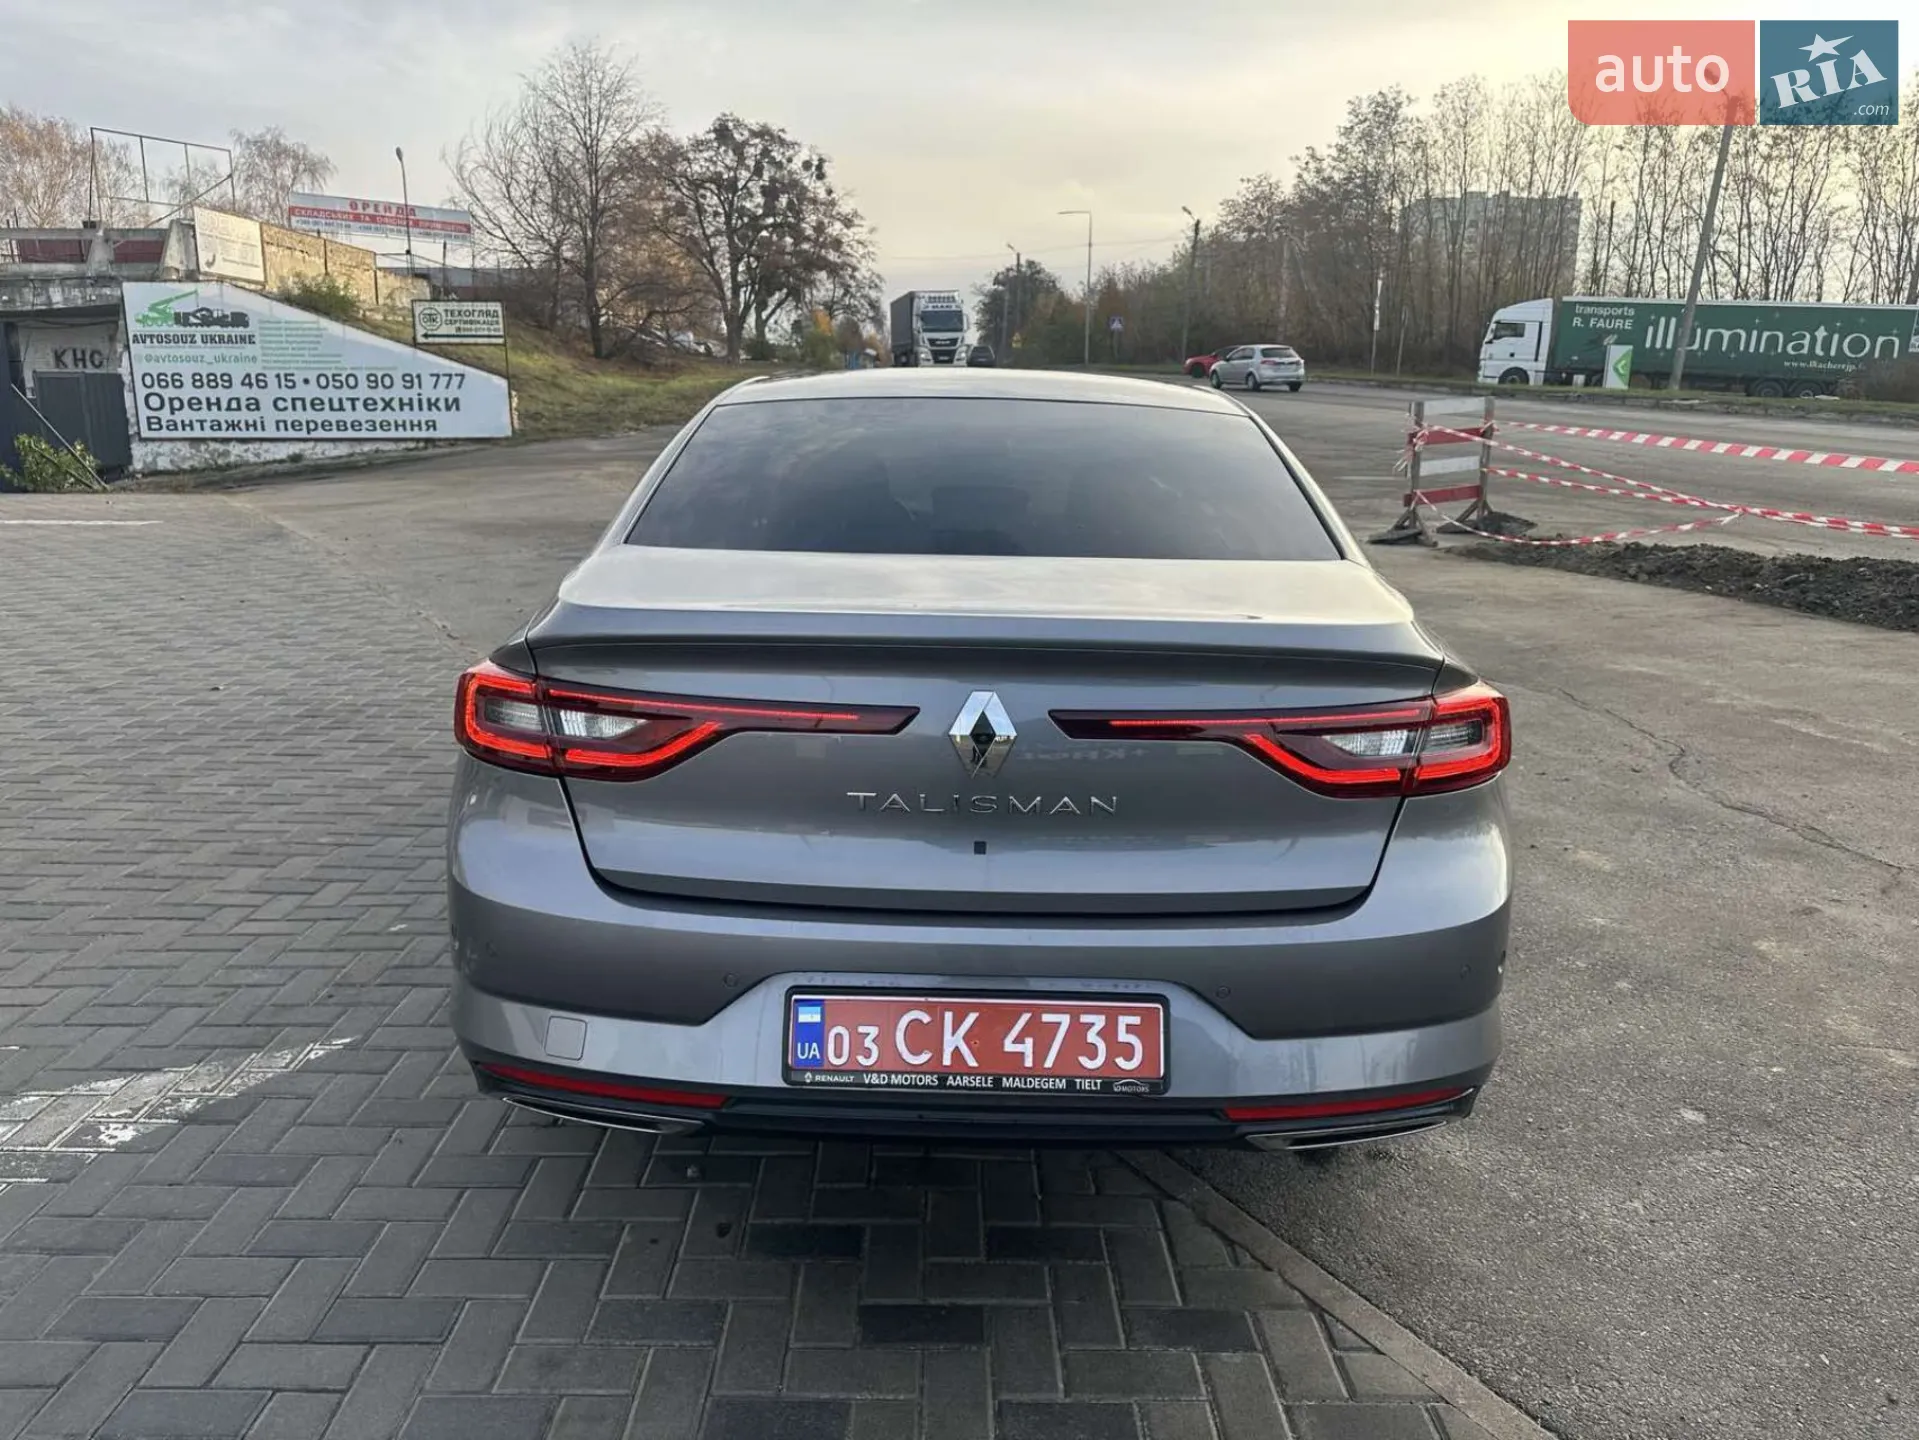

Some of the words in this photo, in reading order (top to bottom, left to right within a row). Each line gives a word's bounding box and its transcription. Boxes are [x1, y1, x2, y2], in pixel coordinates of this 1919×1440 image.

[443, 308, 500, 319] ТЕХОГЛЯД
[1575, 303, 1635, 317] transports
[1572, 316, 1584, 328] R.
[1589, 317, 1634, 330] FAURE
[132, 333, 198, 345] AVTOSOUZ
[201, 333, 257, 345] UKRAINE
[1645, 315, 1901, 359] illumination
[144, 352, 258, 366] @avtosouz_ukraine
[141, 372, 184, 389] 066
[191, 372, 234, 389] 889
[240, 372, 269, 389] 46
[275, 372, 297, 389] 15
[316, 373, 359, 389] 050
[366, 373, 394, 389] 90
[401, 373, 423, 389] 91
[429, 373, 466, 389] 777
[143, 391, 262, 415] Оренда
[272, 393, 461, 414] спецтехніки
[145, 415, 266, 432] Вантажні
[275, 418, 438, 435] перевезення
[846, 791, 1118, 816] TALISMAN
[827, 1025, 880, 1066] 03
[1003, 1012, 1144, 1070] 4735
[797, 1042, 821, 1059] UA
[814, 1075, 855, 1083] RENAULT
[863, 1074, 888, 1085] V&D
[891, 1075, 939, 1086] MOTORS
[946, 1076, 994, 1088] AARSELE
[1002, 1077, 1067, 1090] MALDEGEM
[1074, 1079, 1103, 1091] TIELT
